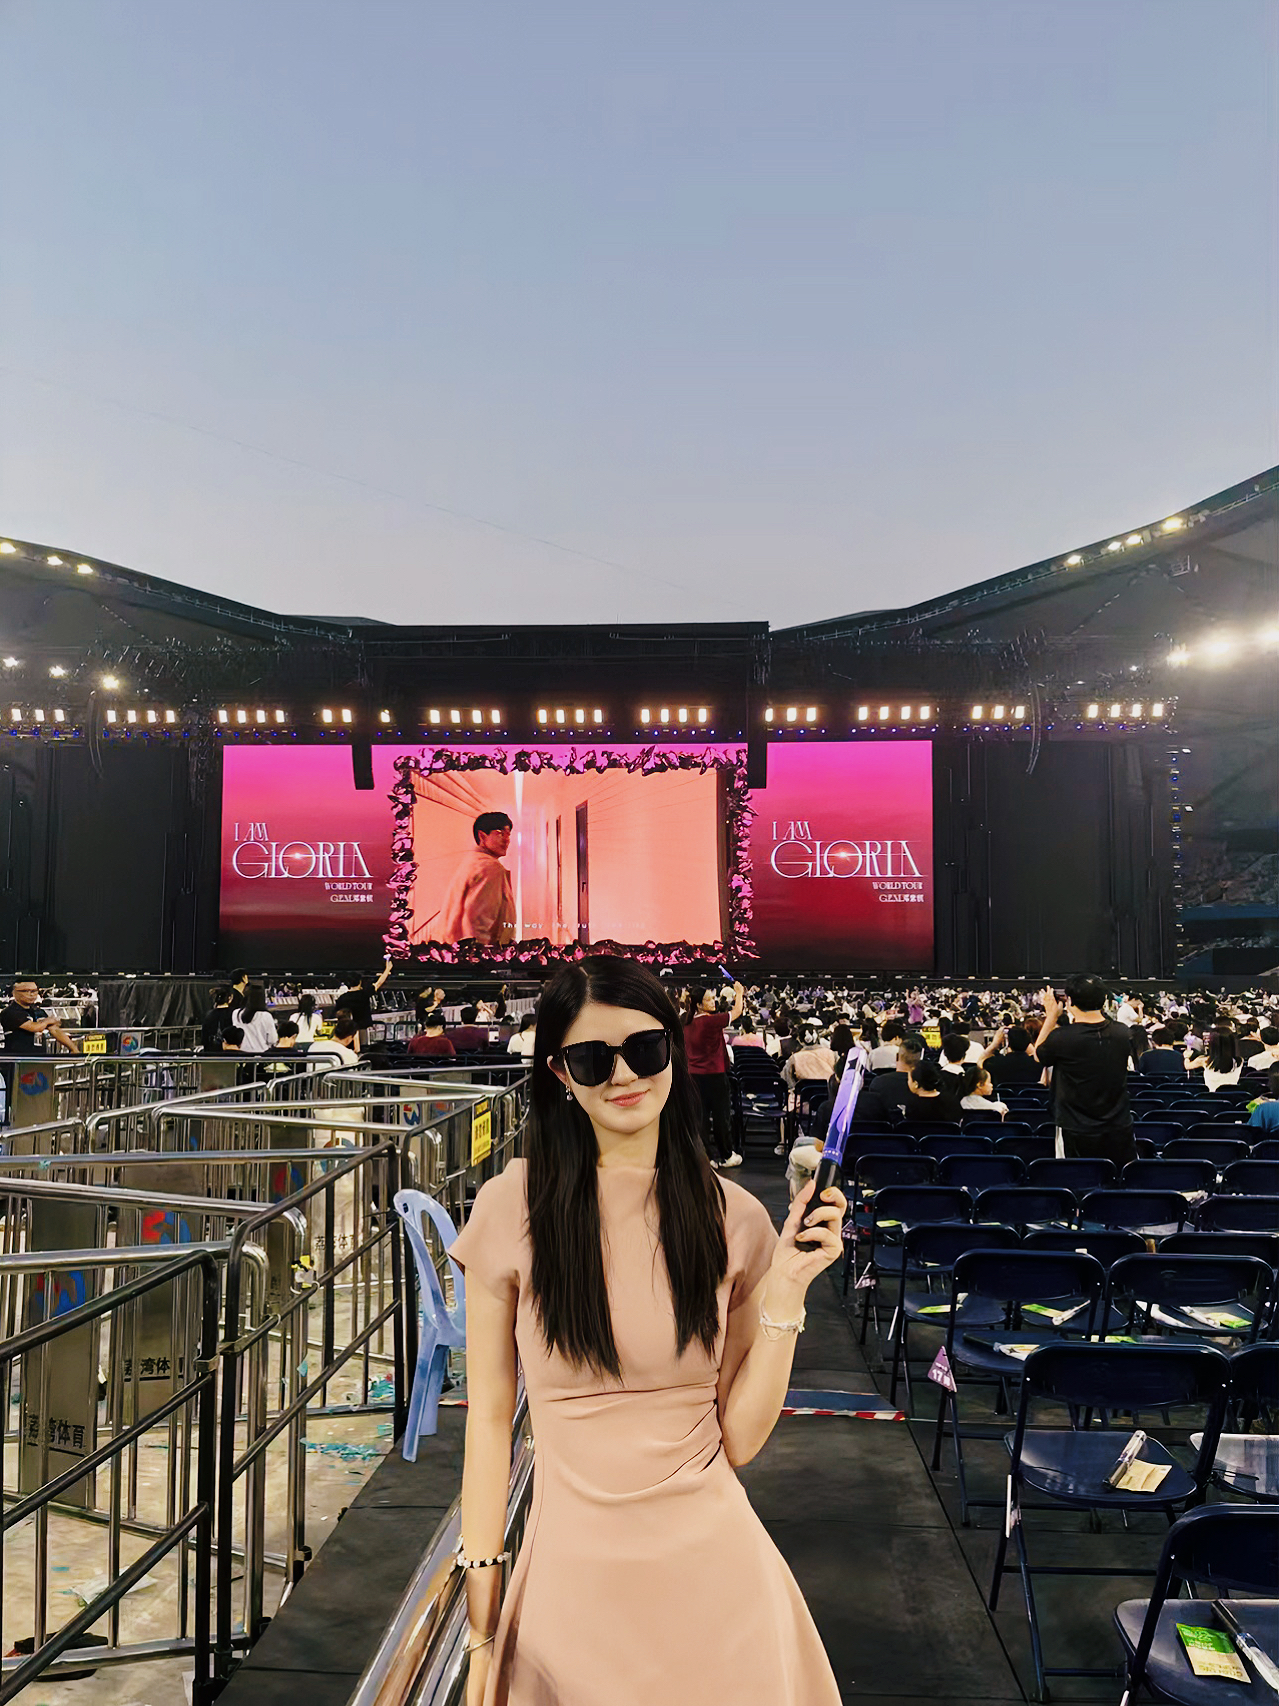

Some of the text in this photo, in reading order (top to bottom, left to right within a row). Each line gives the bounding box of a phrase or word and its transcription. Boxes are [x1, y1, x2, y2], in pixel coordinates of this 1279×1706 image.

[243, 822, 269, 841] AM
[783, 821, 813, 840] AM
[232, 841, 374, 879] GLORIA
[770, 840, 924, 878] GLORIA
